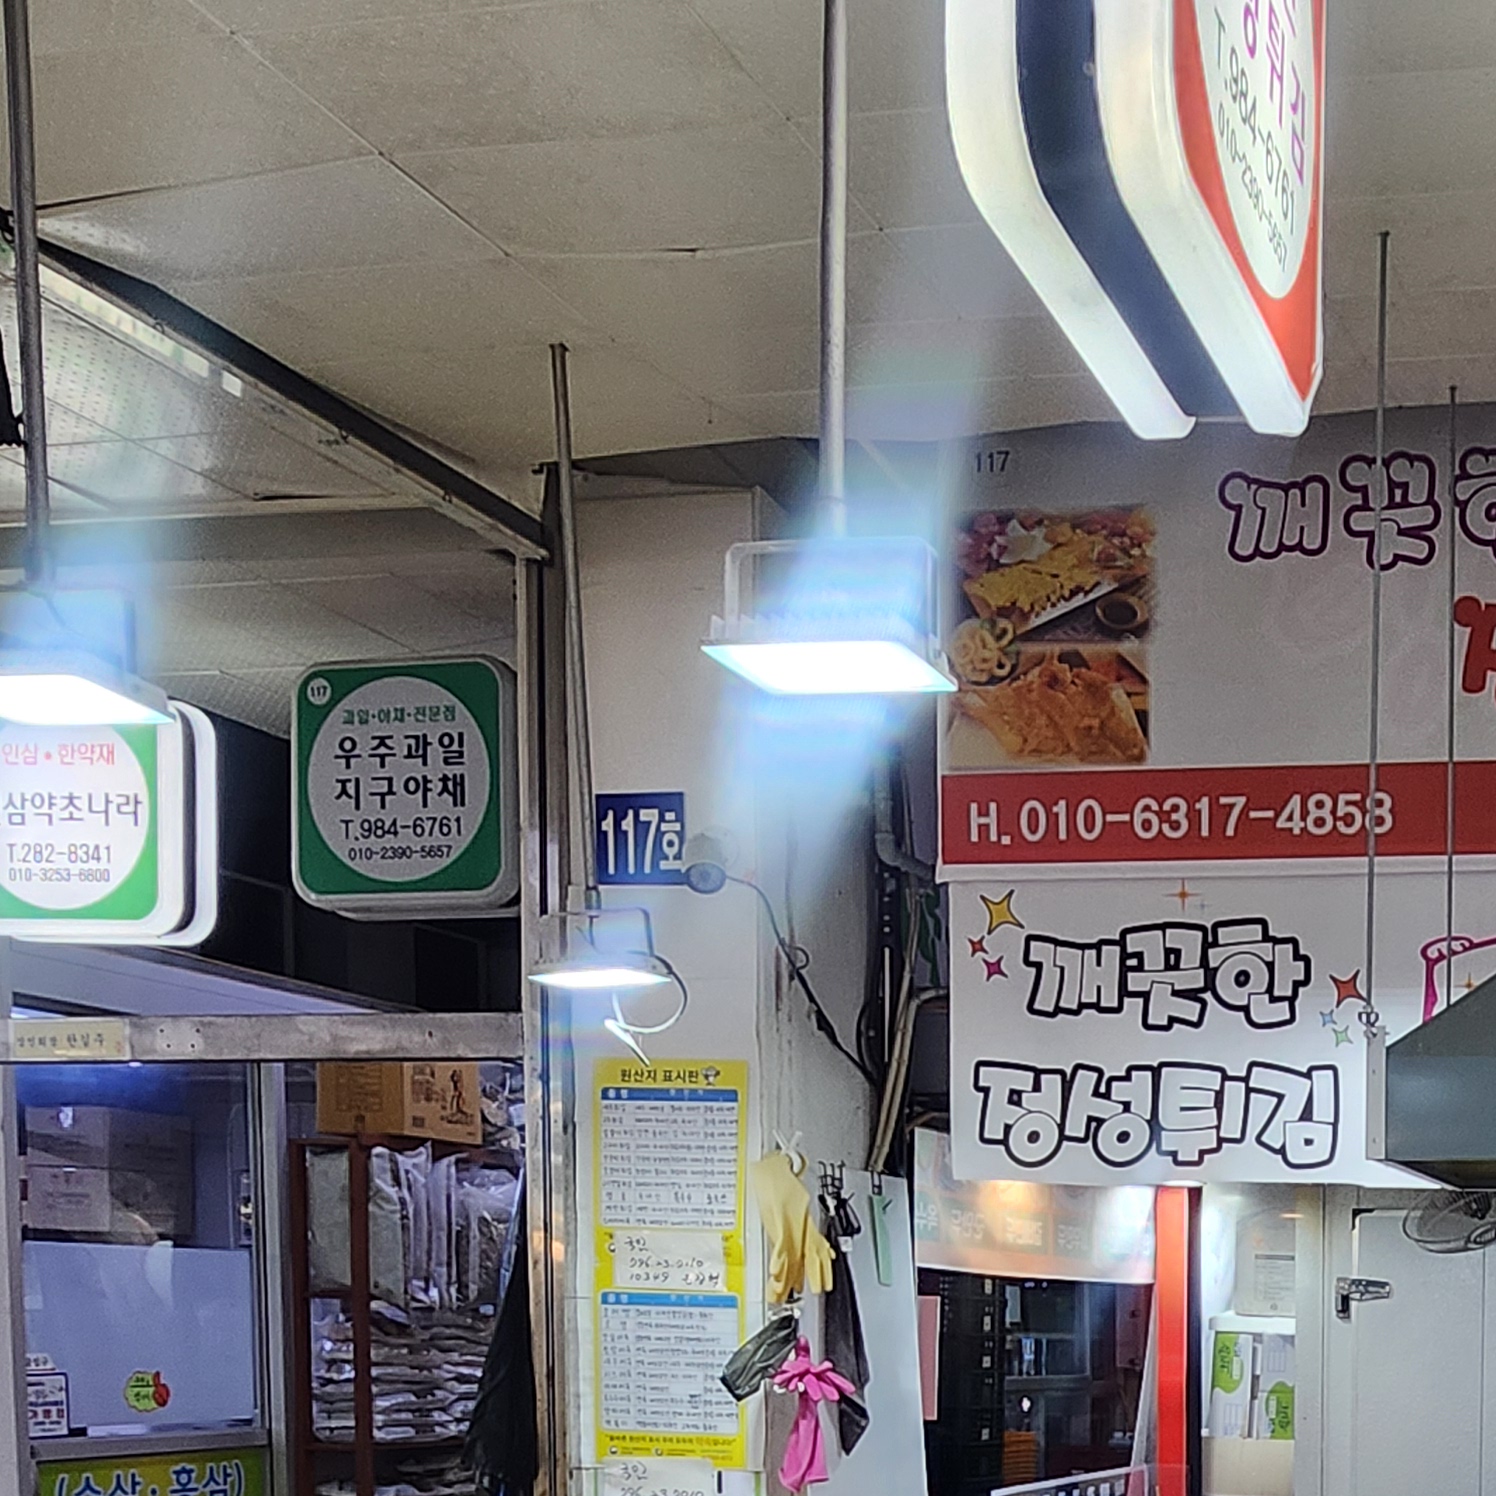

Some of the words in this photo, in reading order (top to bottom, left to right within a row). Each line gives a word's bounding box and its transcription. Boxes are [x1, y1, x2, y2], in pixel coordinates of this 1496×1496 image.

[974, 450, 1010, 472] 117
[310, 685, 328, 698] 117
[333, 732, 466, 769] 우주과일
[333, 773, 466, 811] 지구야채
[0, 791, 143, 827] 삼약초나라
[340, 816, 462, 842] T.984-6761
[600, 808, 686, 876] 117호
[7, 843, 111, 864] T.282-8341
[348, 846, 453, 861] 010-2390-5657
[1023, 917, 1312, 1031] 깨끗한
[620, 1068, 658, 1084] 원산지
[662, 1068, 700, 1084] 표시판
[973, 1060, 1340, 1169] 정성튀김
